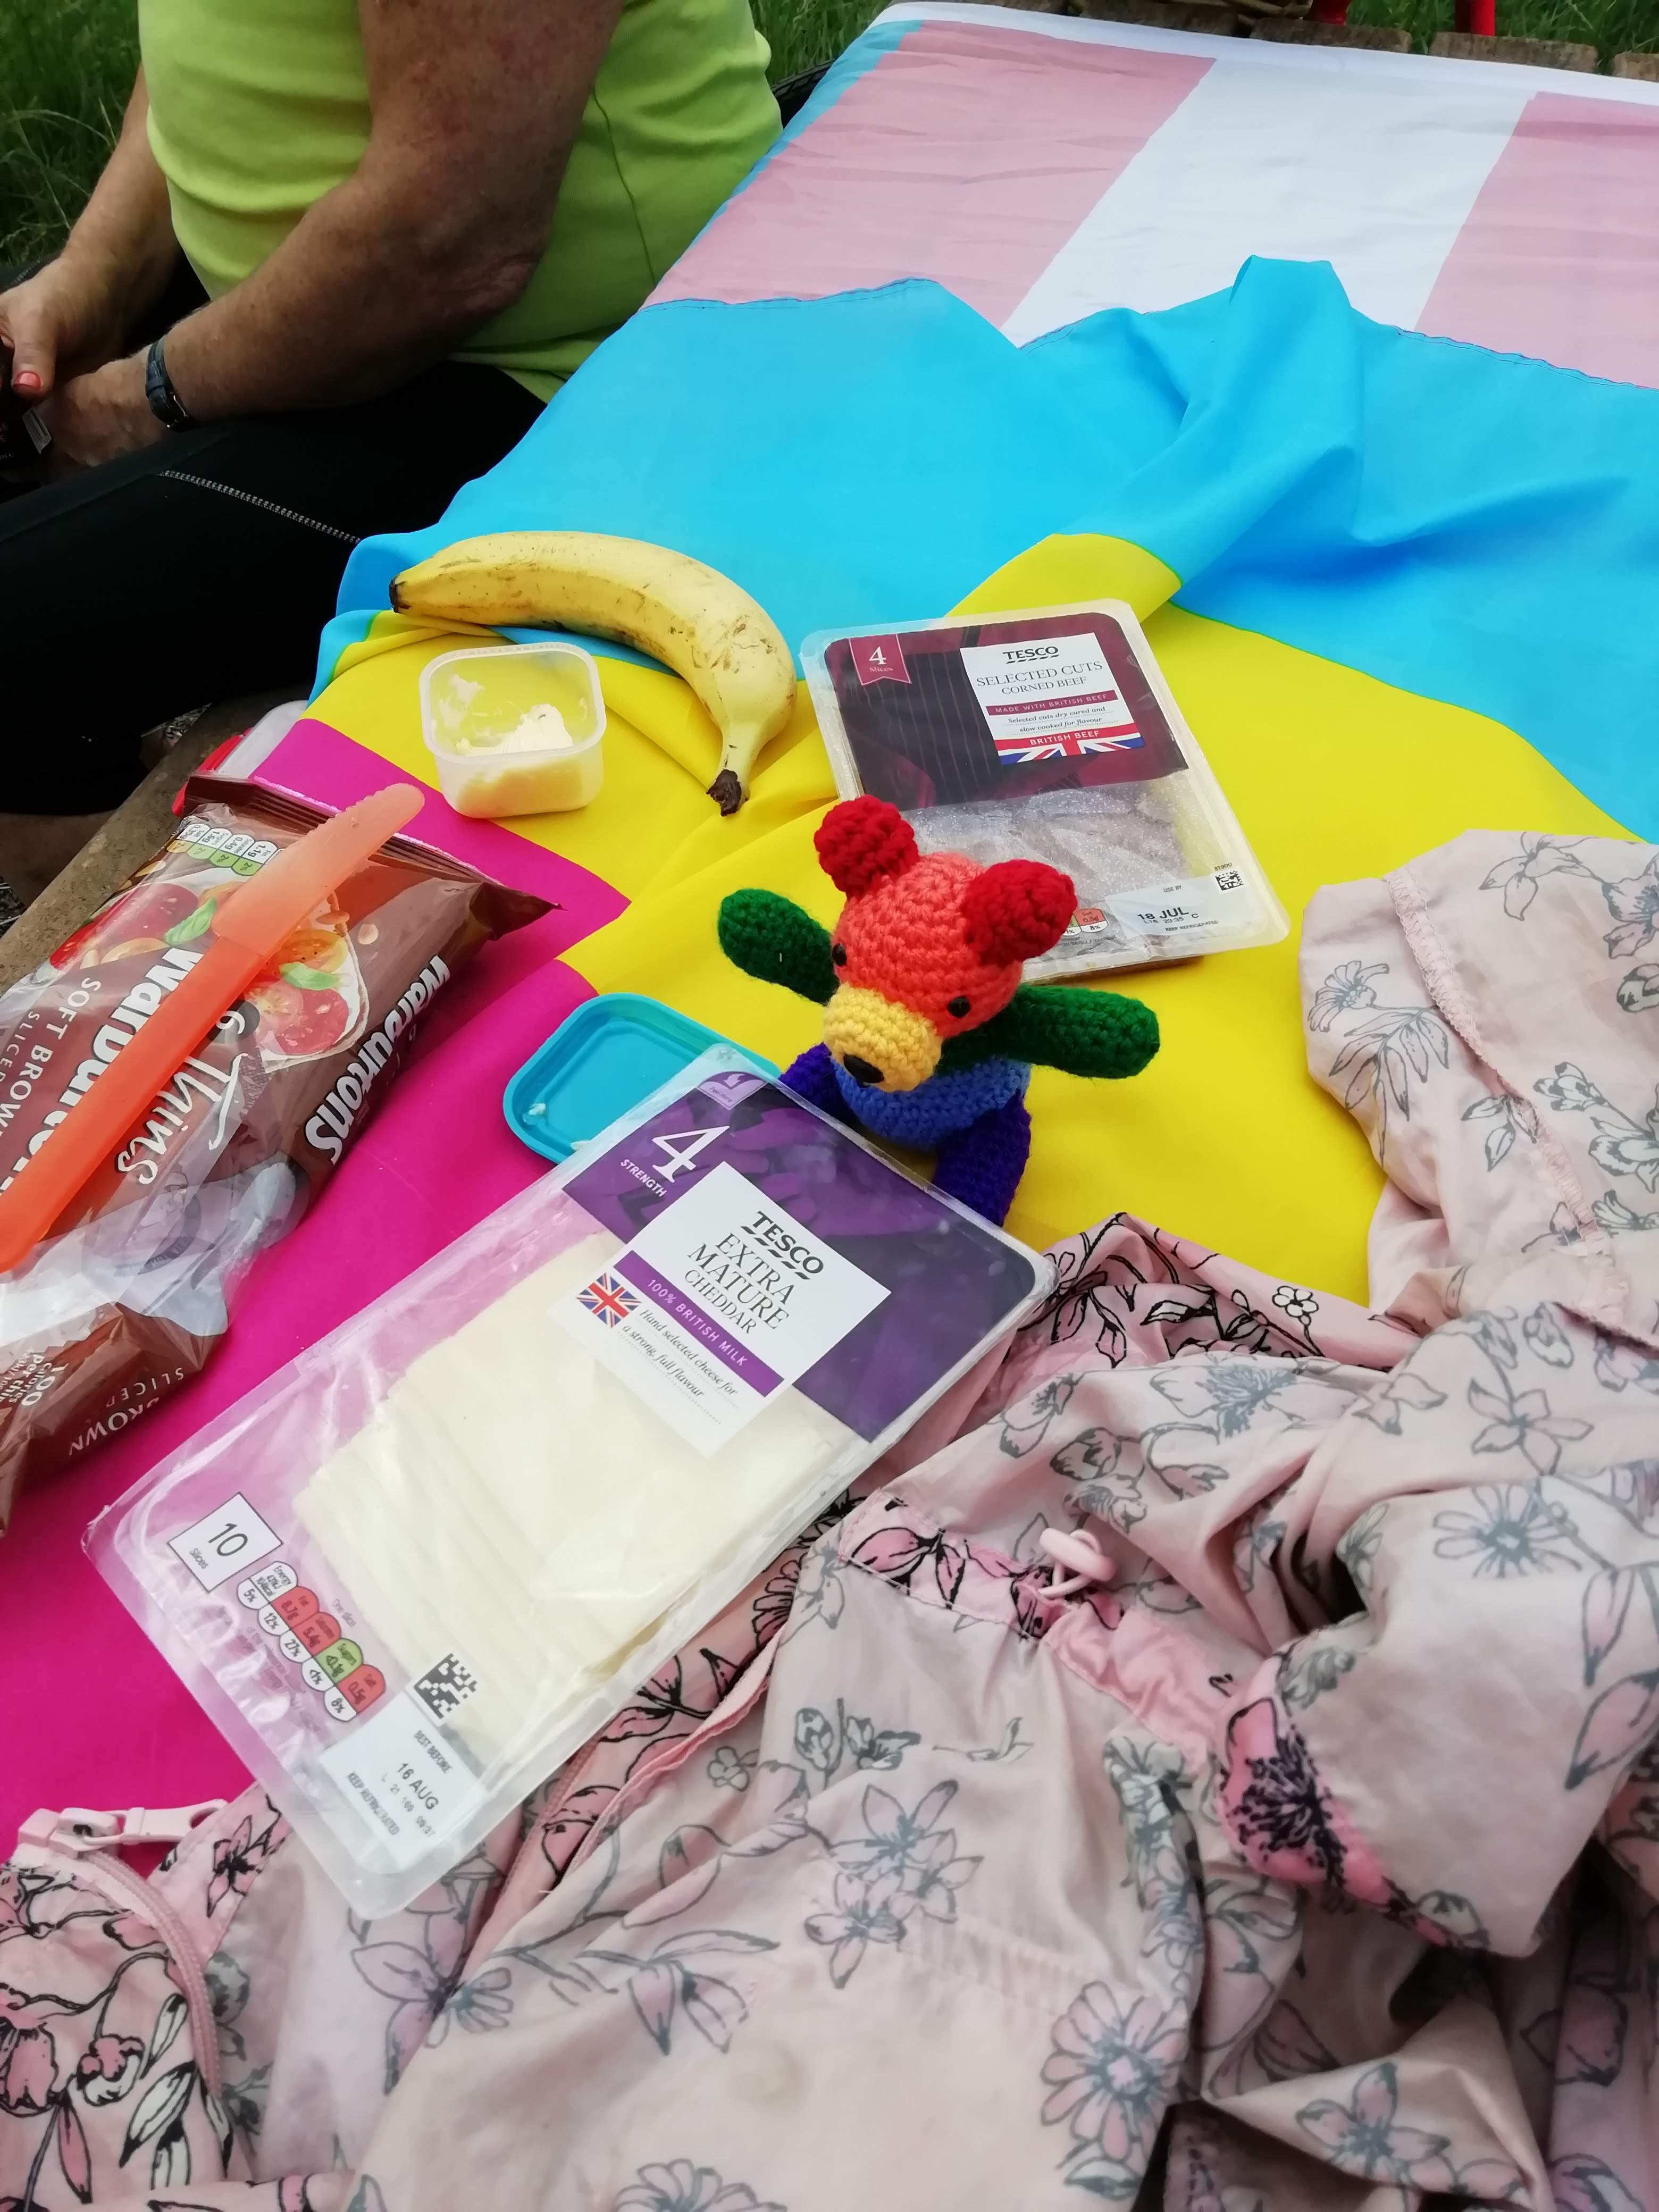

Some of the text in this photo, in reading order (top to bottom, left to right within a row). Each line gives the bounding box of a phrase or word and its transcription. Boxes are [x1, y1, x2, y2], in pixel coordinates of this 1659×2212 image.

[869, 646, 887, 665] 4
[1002, 646, 1059, 660] TESCO
[976, 661, 1103, 686] SELECTED CUTS
[1001, 676, 1087, 694] CORNED BEEF
[1049, 698, 1083, 708] BRITISH
[1037, 722, 1062, 731] cooked
[1063, 720, 1075, 728] for
[1076, 717, 1102, 726] flavour
[1029, 730, 1099, 745] BRITISH BEEF
[202, 831, 221, 843] 1.6g
[224, 837, 243, 850] 0.4g
[216, 854, 229, 863] 2%
[247, 844, 266, 858] 1.1g
[239, 861, 253, 871] 2%
[1159, 907, 1189, 919] JUL
[1179, 920, 1219, 930] REFRIGERATED
[216, 1010, 246, 1034] 6
[0, 977, 102, 1137] SOFT BROW
[305, 954, 450, 1166] Warburtons
[116, 1053, 249, 1185] Thins
[651, 1125, 730, 1183] 4
[620, 1159, 667, 1197] STRENGTH
[752, 1210, 824, 1274] TESCO
[715, 1233, 795, 1305] EXTRA
[687, 1243, 790, 1329] MATURE
[684, 1269, 757, 1334] CHEDDAR
[647, 1279, 748, 1367] 100% BRITISH MILK
[629, 1330, 658, 1358] strong,
[653, 1354, 677, 1371] full
[668, 1368, 705, 1397] flavour
[639, 1309, 738, 1395] Hand selected cheese for
[22, 1354, 45, 1378] per
[21, 1362, 70, 1406] 100
[106, 1367, 185, 1408] SLICED
[208, 1522, 248, 1557] 10
[189, 1547, 209, 1569] Slices
[273, 1565, 292, 1586] Energy
[243, 1588, 257, 1603] 5%
[263, 1612, 280, 1630] 12%
[284, 1639, 301, 1657] 27%
[331, 1697, 345, 1714] 8%
[414, 1729, 453, 1774] BEST BEFORE
[397, 1763, 439, 1810] 16 AUG
[346, 1771, 400, 1836] KEEP REFRIGERATED
